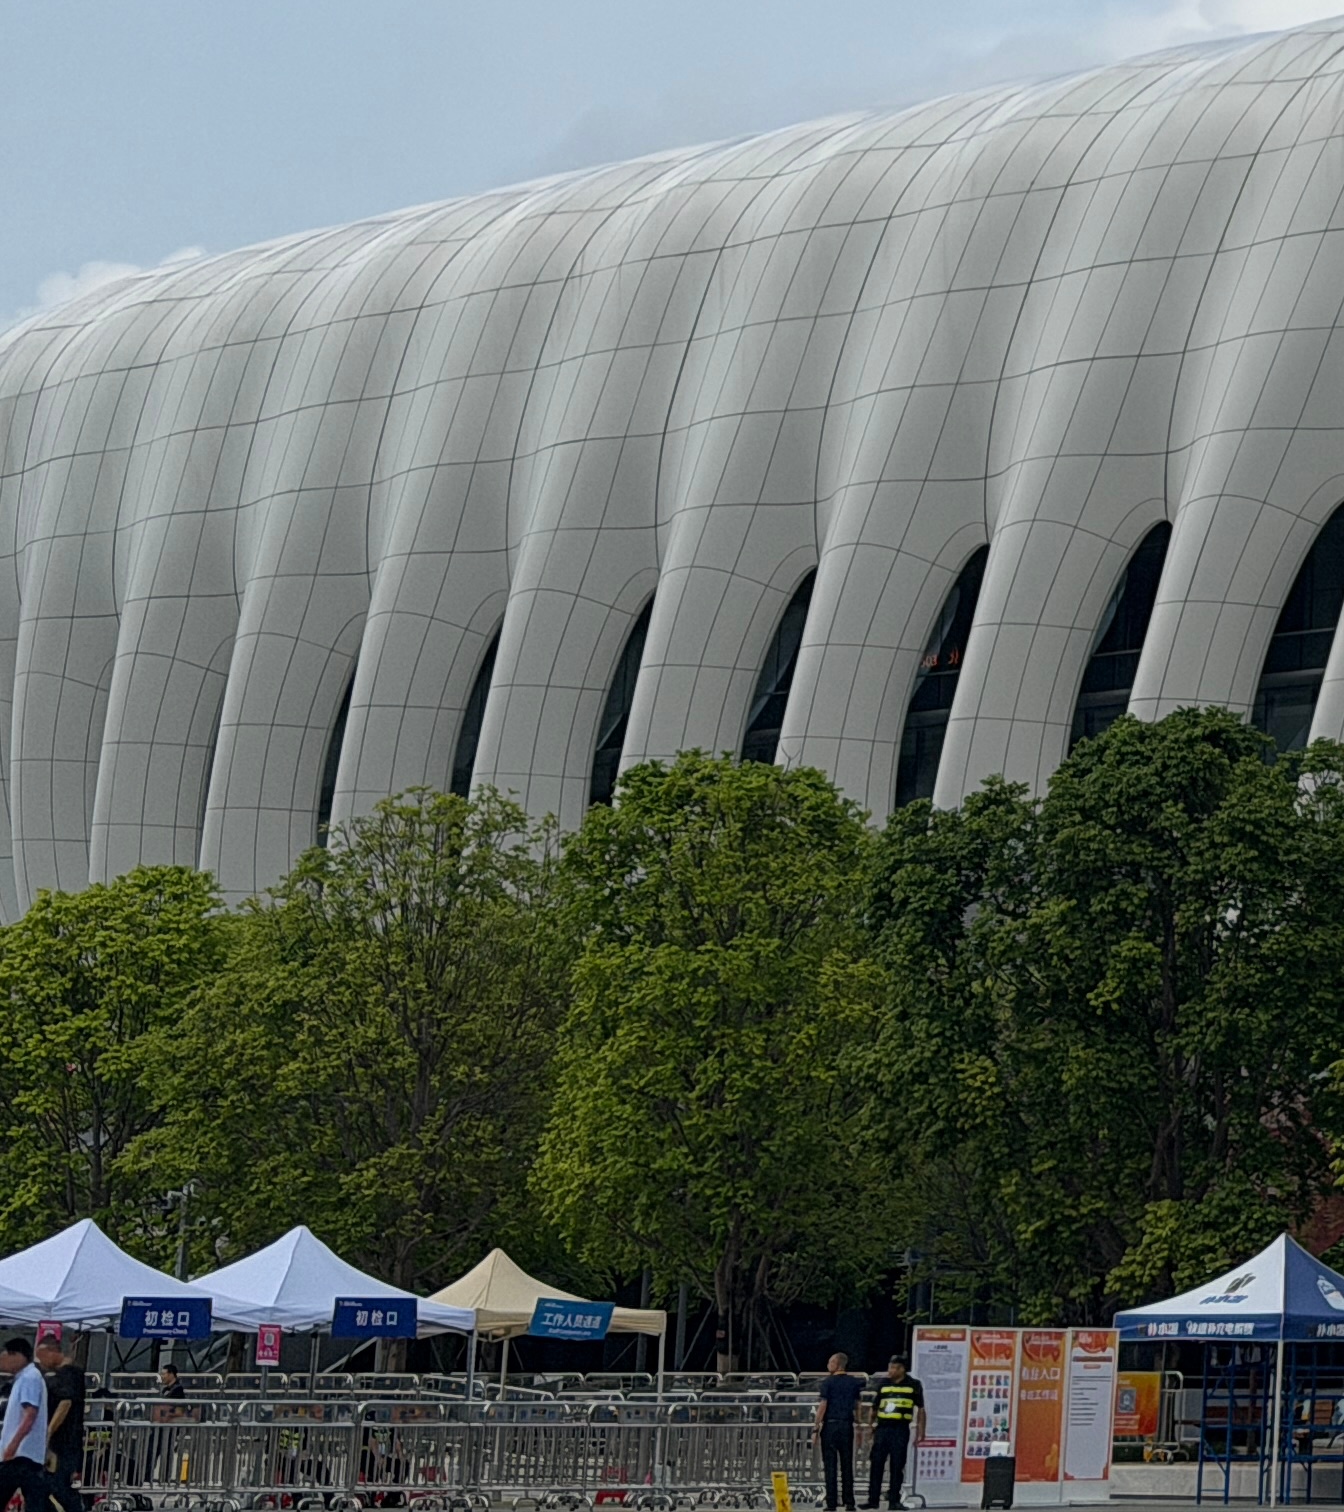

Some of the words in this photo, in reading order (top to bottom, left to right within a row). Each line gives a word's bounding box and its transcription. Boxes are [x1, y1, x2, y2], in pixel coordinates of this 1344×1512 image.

[144, 1309, 190, 1327] 初检口
[355, 1309, 398, 1327] 初检口
